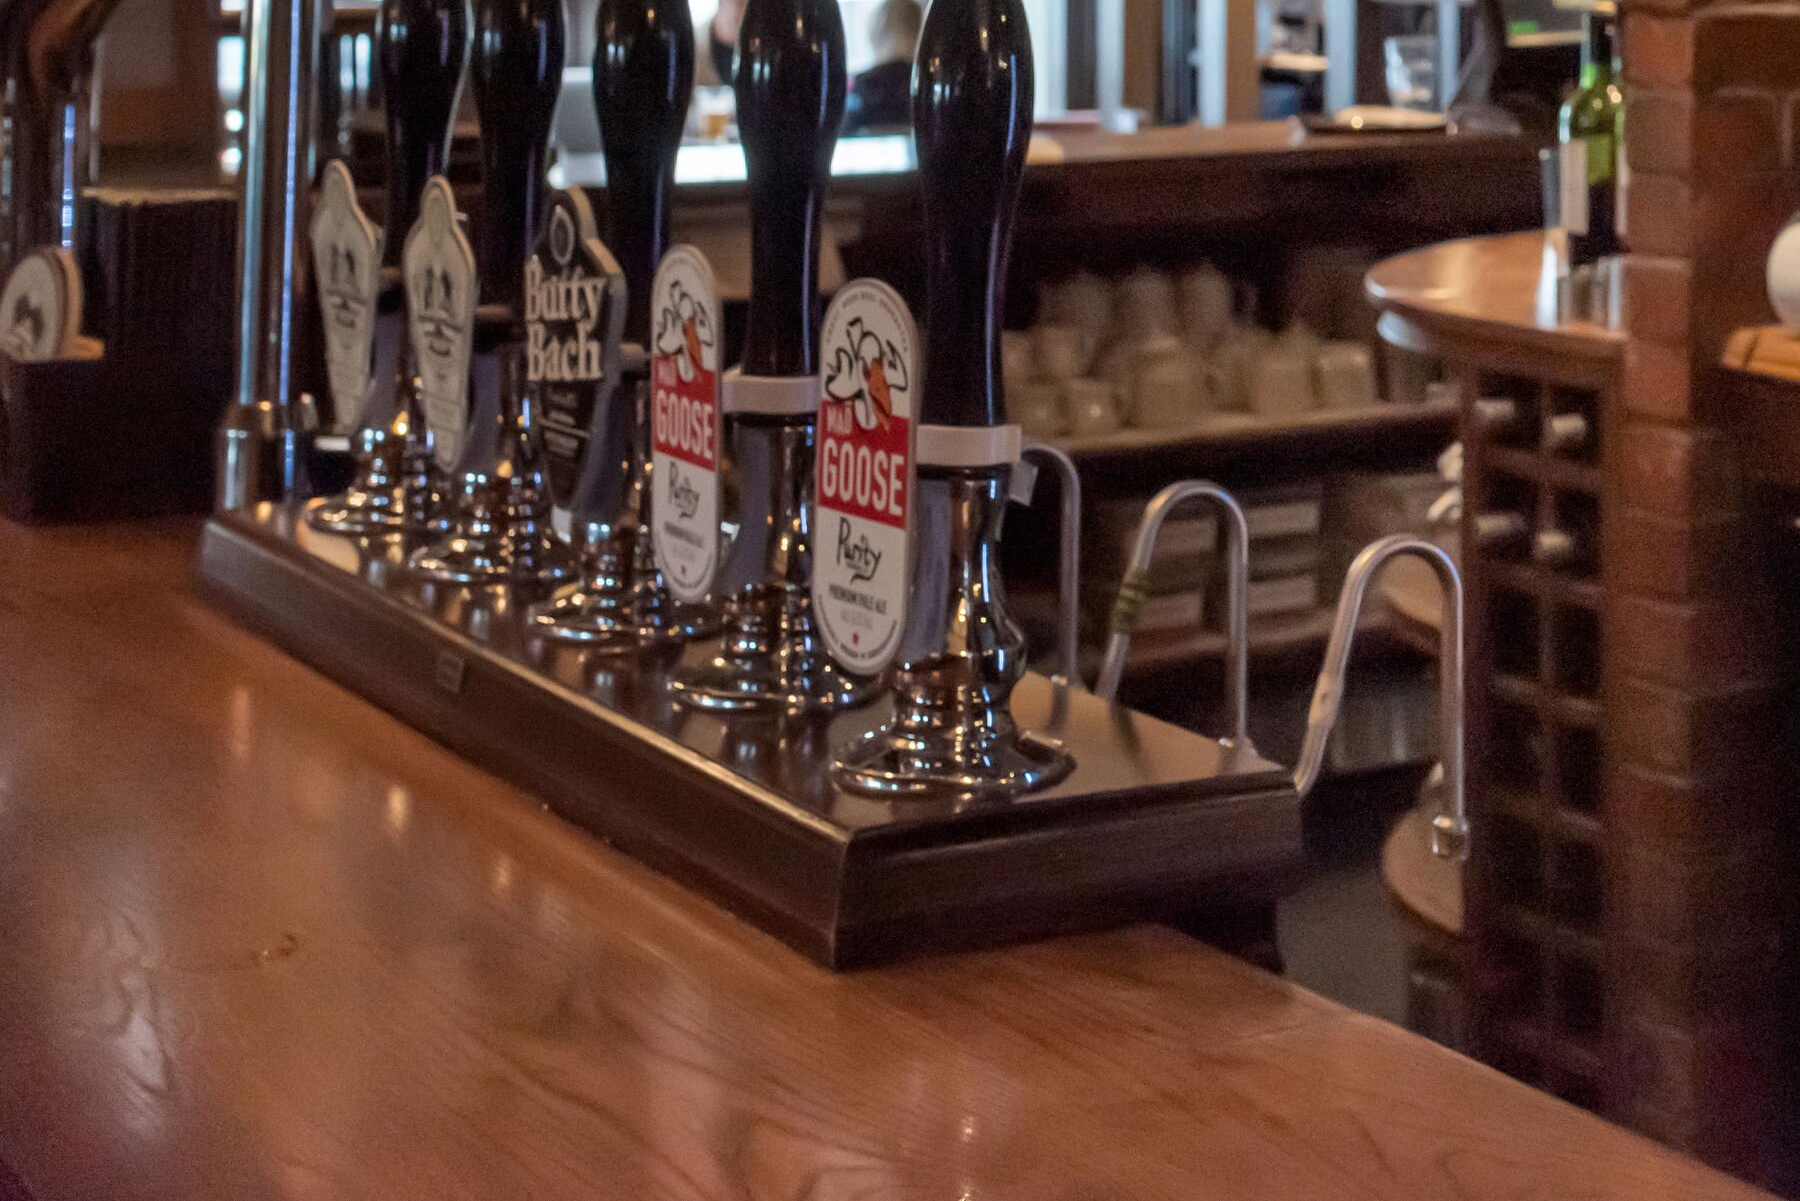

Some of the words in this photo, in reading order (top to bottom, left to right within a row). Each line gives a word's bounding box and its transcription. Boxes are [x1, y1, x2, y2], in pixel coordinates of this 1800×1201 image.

[528, 319, 603, 381] Bach
[656, 389, 713, 460] GOOSE
[822, 437, 904, 517] GOOSE
